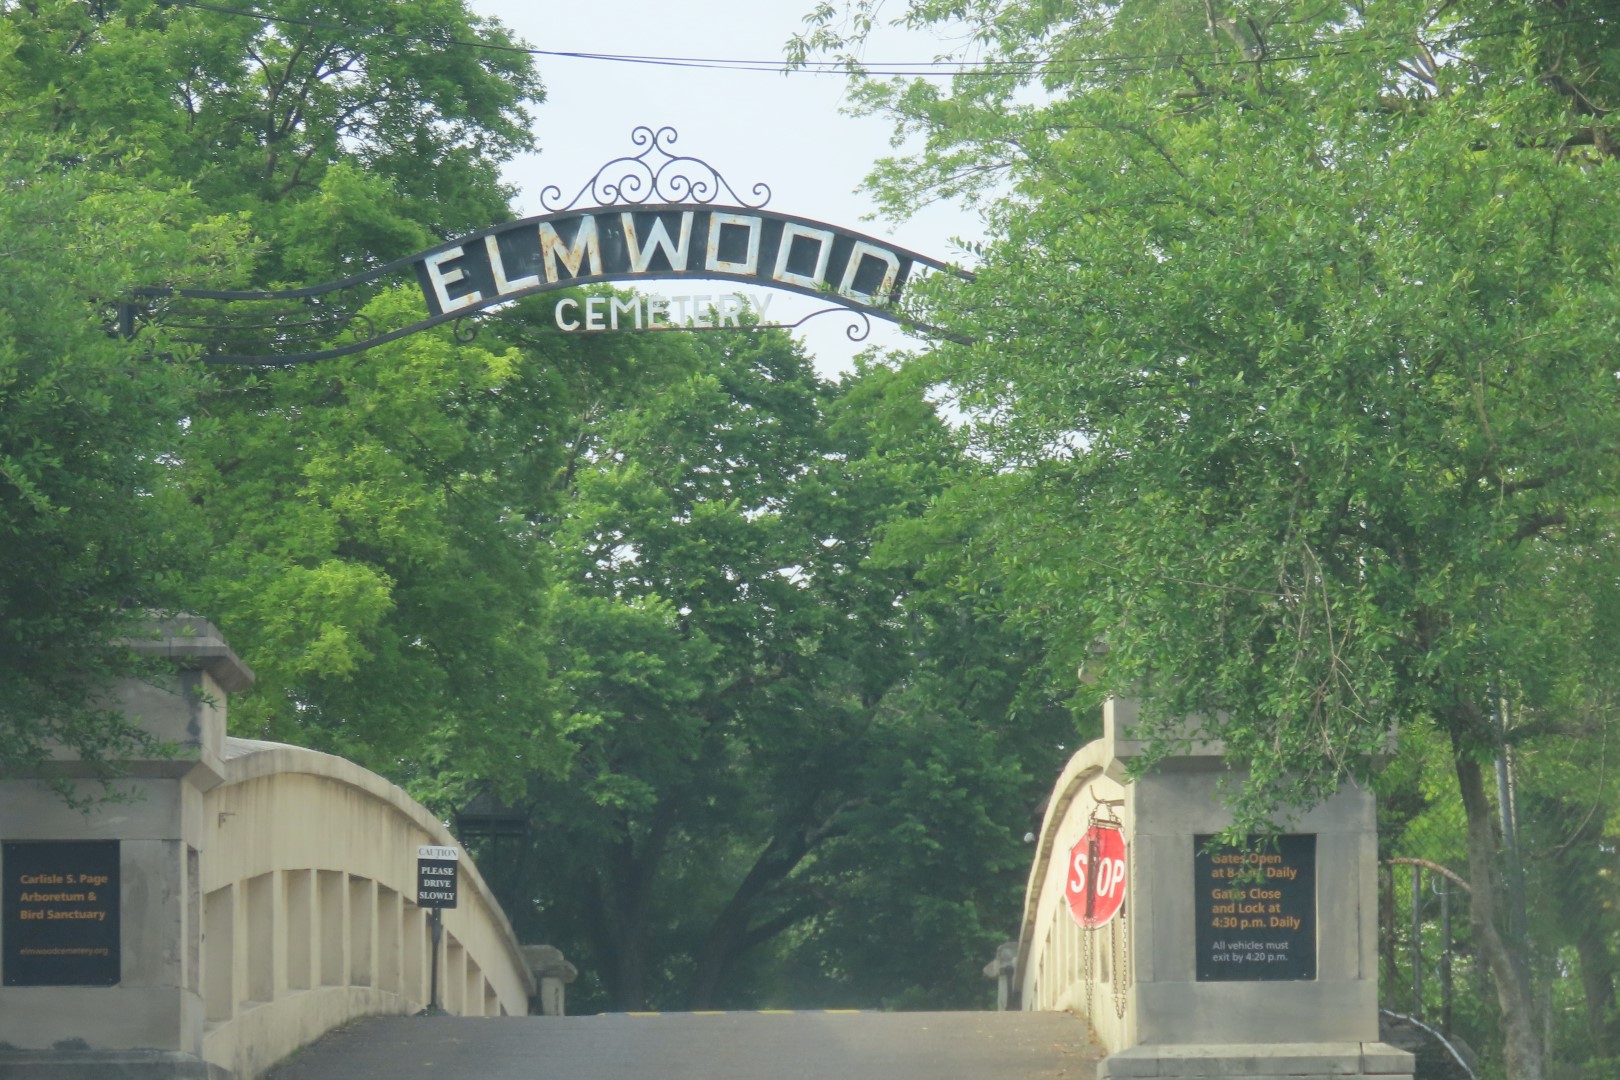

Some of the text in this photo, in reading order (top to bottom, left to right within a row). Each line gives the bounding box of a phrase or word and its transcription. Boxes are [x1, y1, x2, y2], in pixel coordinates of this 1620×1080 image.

[423, 210, 900, 314] ELMWOOD
[555, 293, 774, 332] CEMETERY
[418, 848, 457, 857] CAUTION
[1249, 853, 1282, 866] Open
[421, 866, 454, 876] PLEASE
[1070, 853, 1125, 898] SOP
[1211, 868, 1225, 878] at
[1267, 867, 1297, 880] Daily
[20, 874, 108, 886] Carlisle S. Page
[423, 879, 451, 888] DRIVE
[20, 891, 97, 902] Arboretum &
[419, 891, 455, 900] SLOWLY
[1249, 888, 1282, 899] Close
[1211, 902, 1281, 914] and Lock at
[20, 910, 106, 921] Bird Sanctuary
[1212, 916, 1300, 930] 4:30 p.m. Daily
[1212, 941, 1289, 950] All vehicles must
[1212, 953, 1288, 963] exit by 4:20 p.m.
